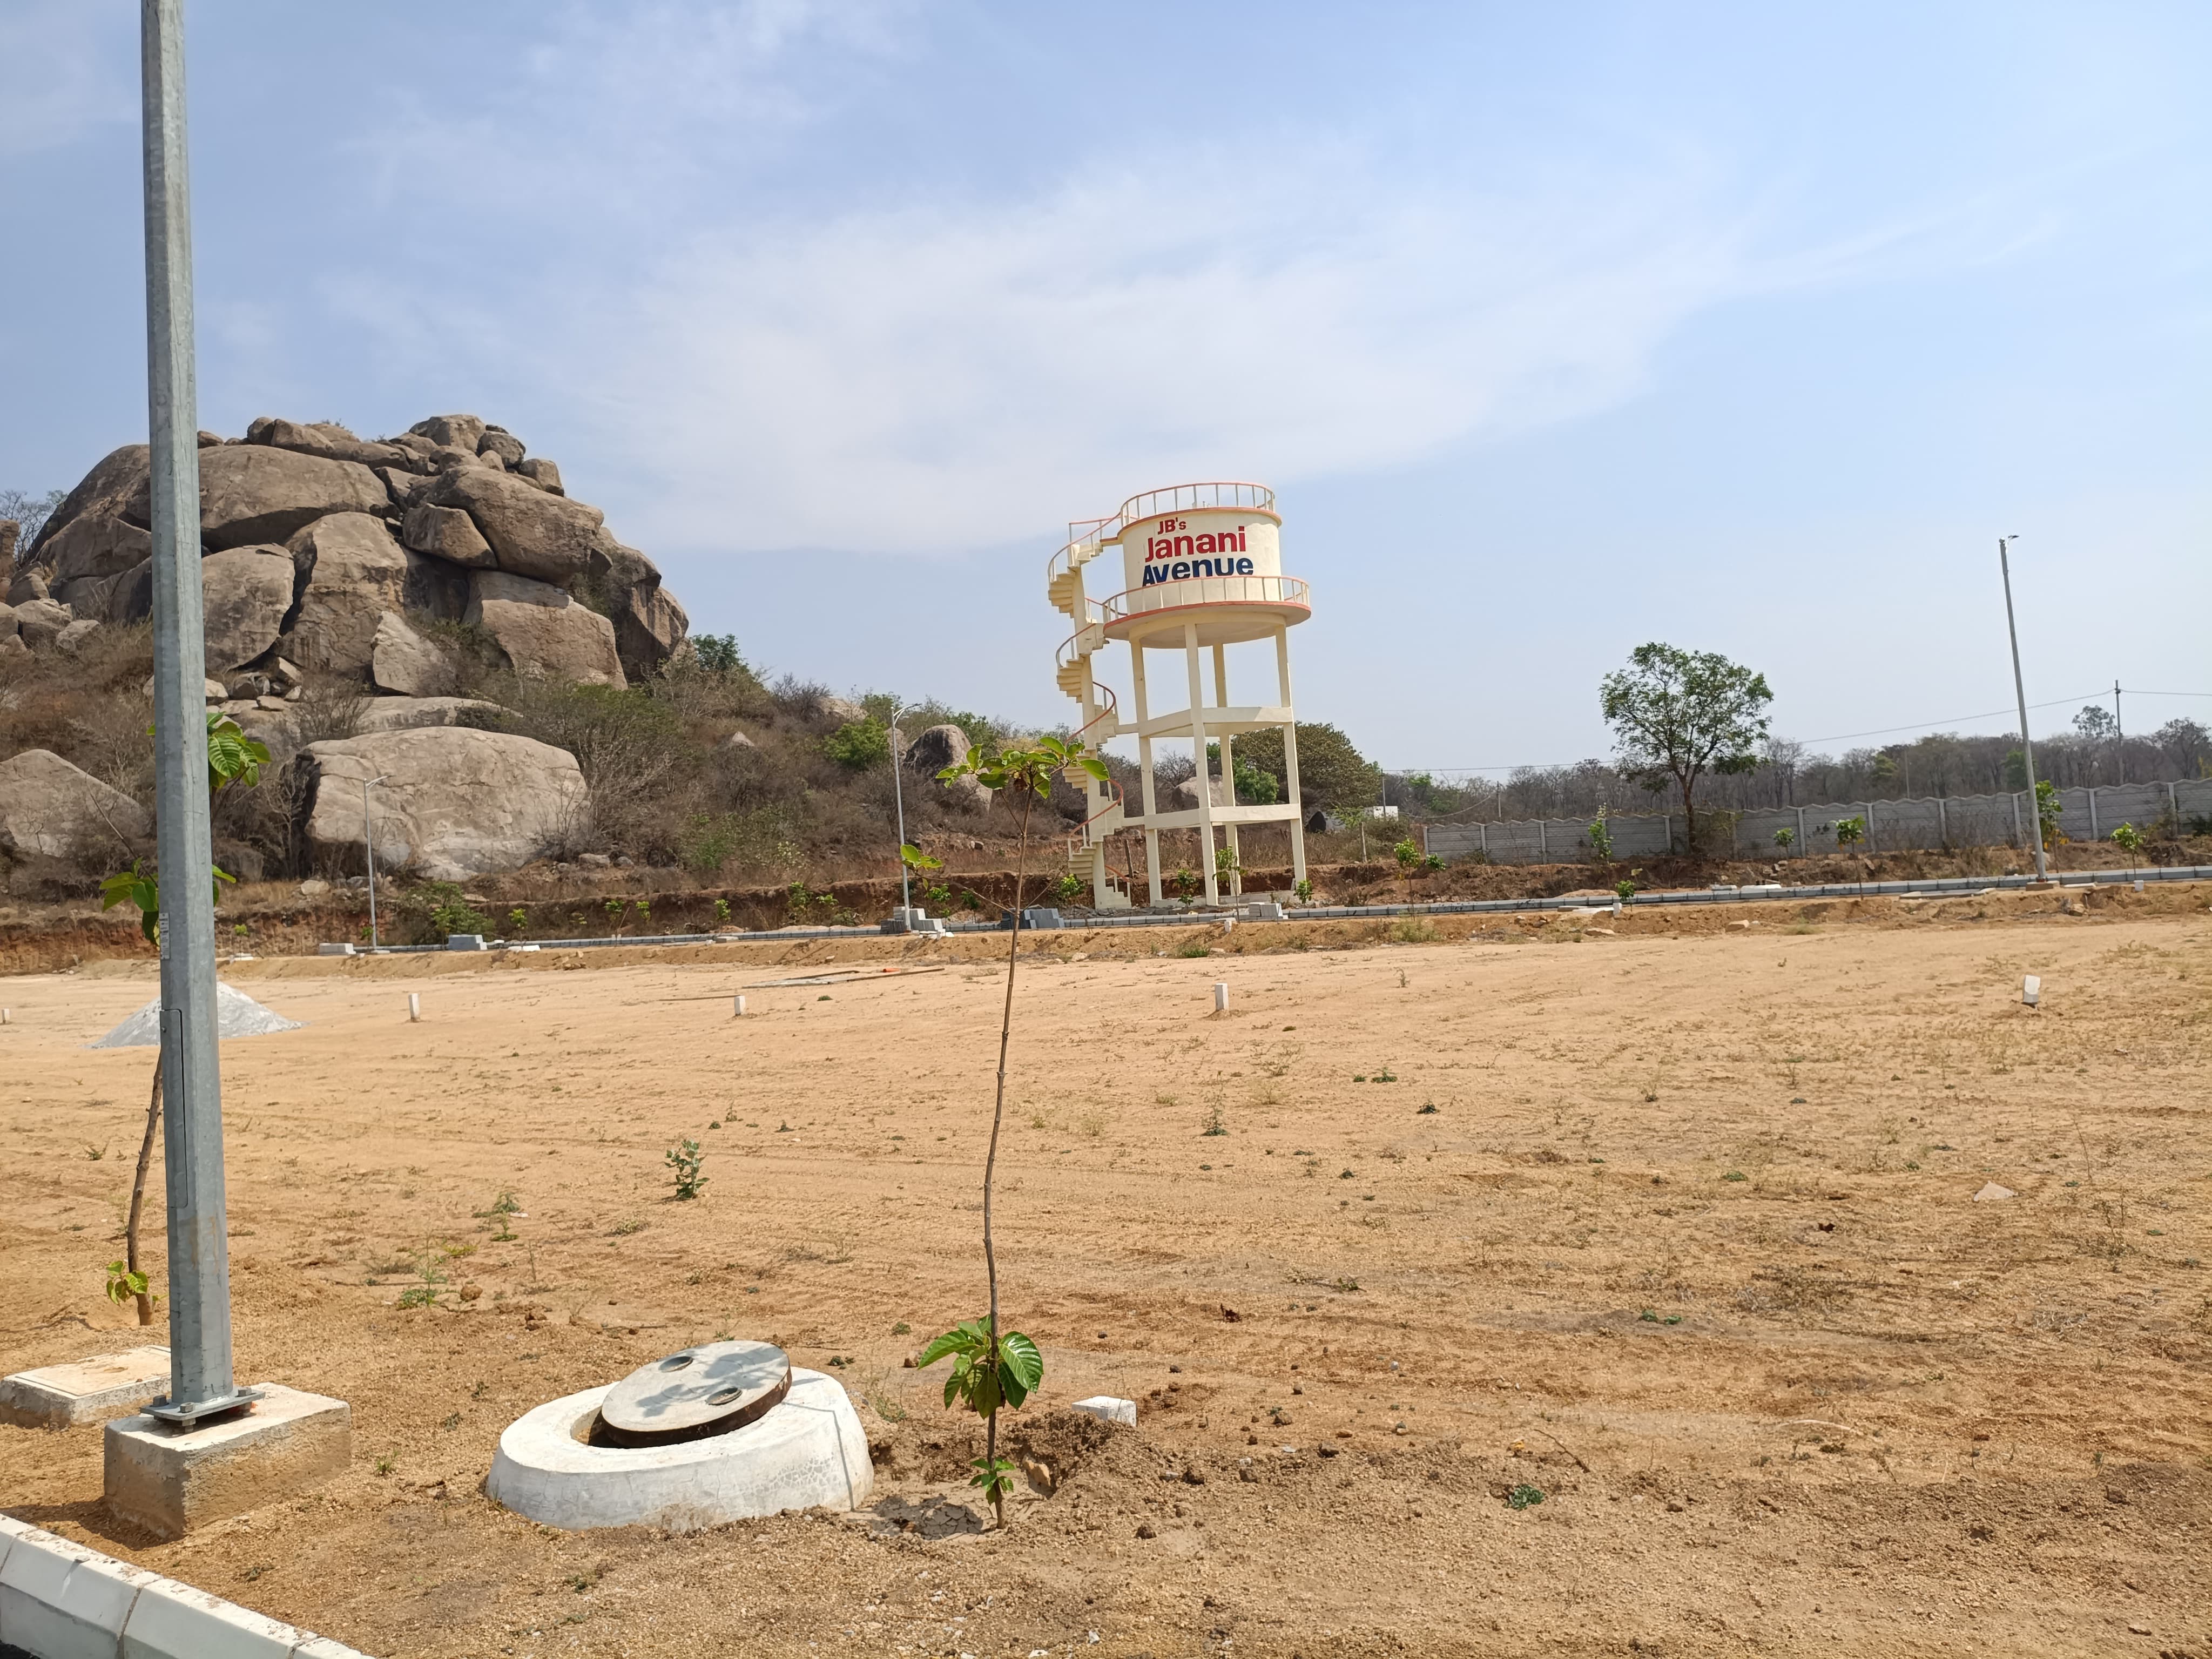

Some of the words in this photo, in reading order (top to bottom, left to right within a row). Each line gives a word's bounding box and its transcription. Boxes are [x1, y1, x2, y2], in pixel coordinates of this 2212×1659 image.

[1157, 517, 1186, 535] JB's
[1145, 526, 1246, 562] Janani
[1142, 557, 1253, 586] Avenue
